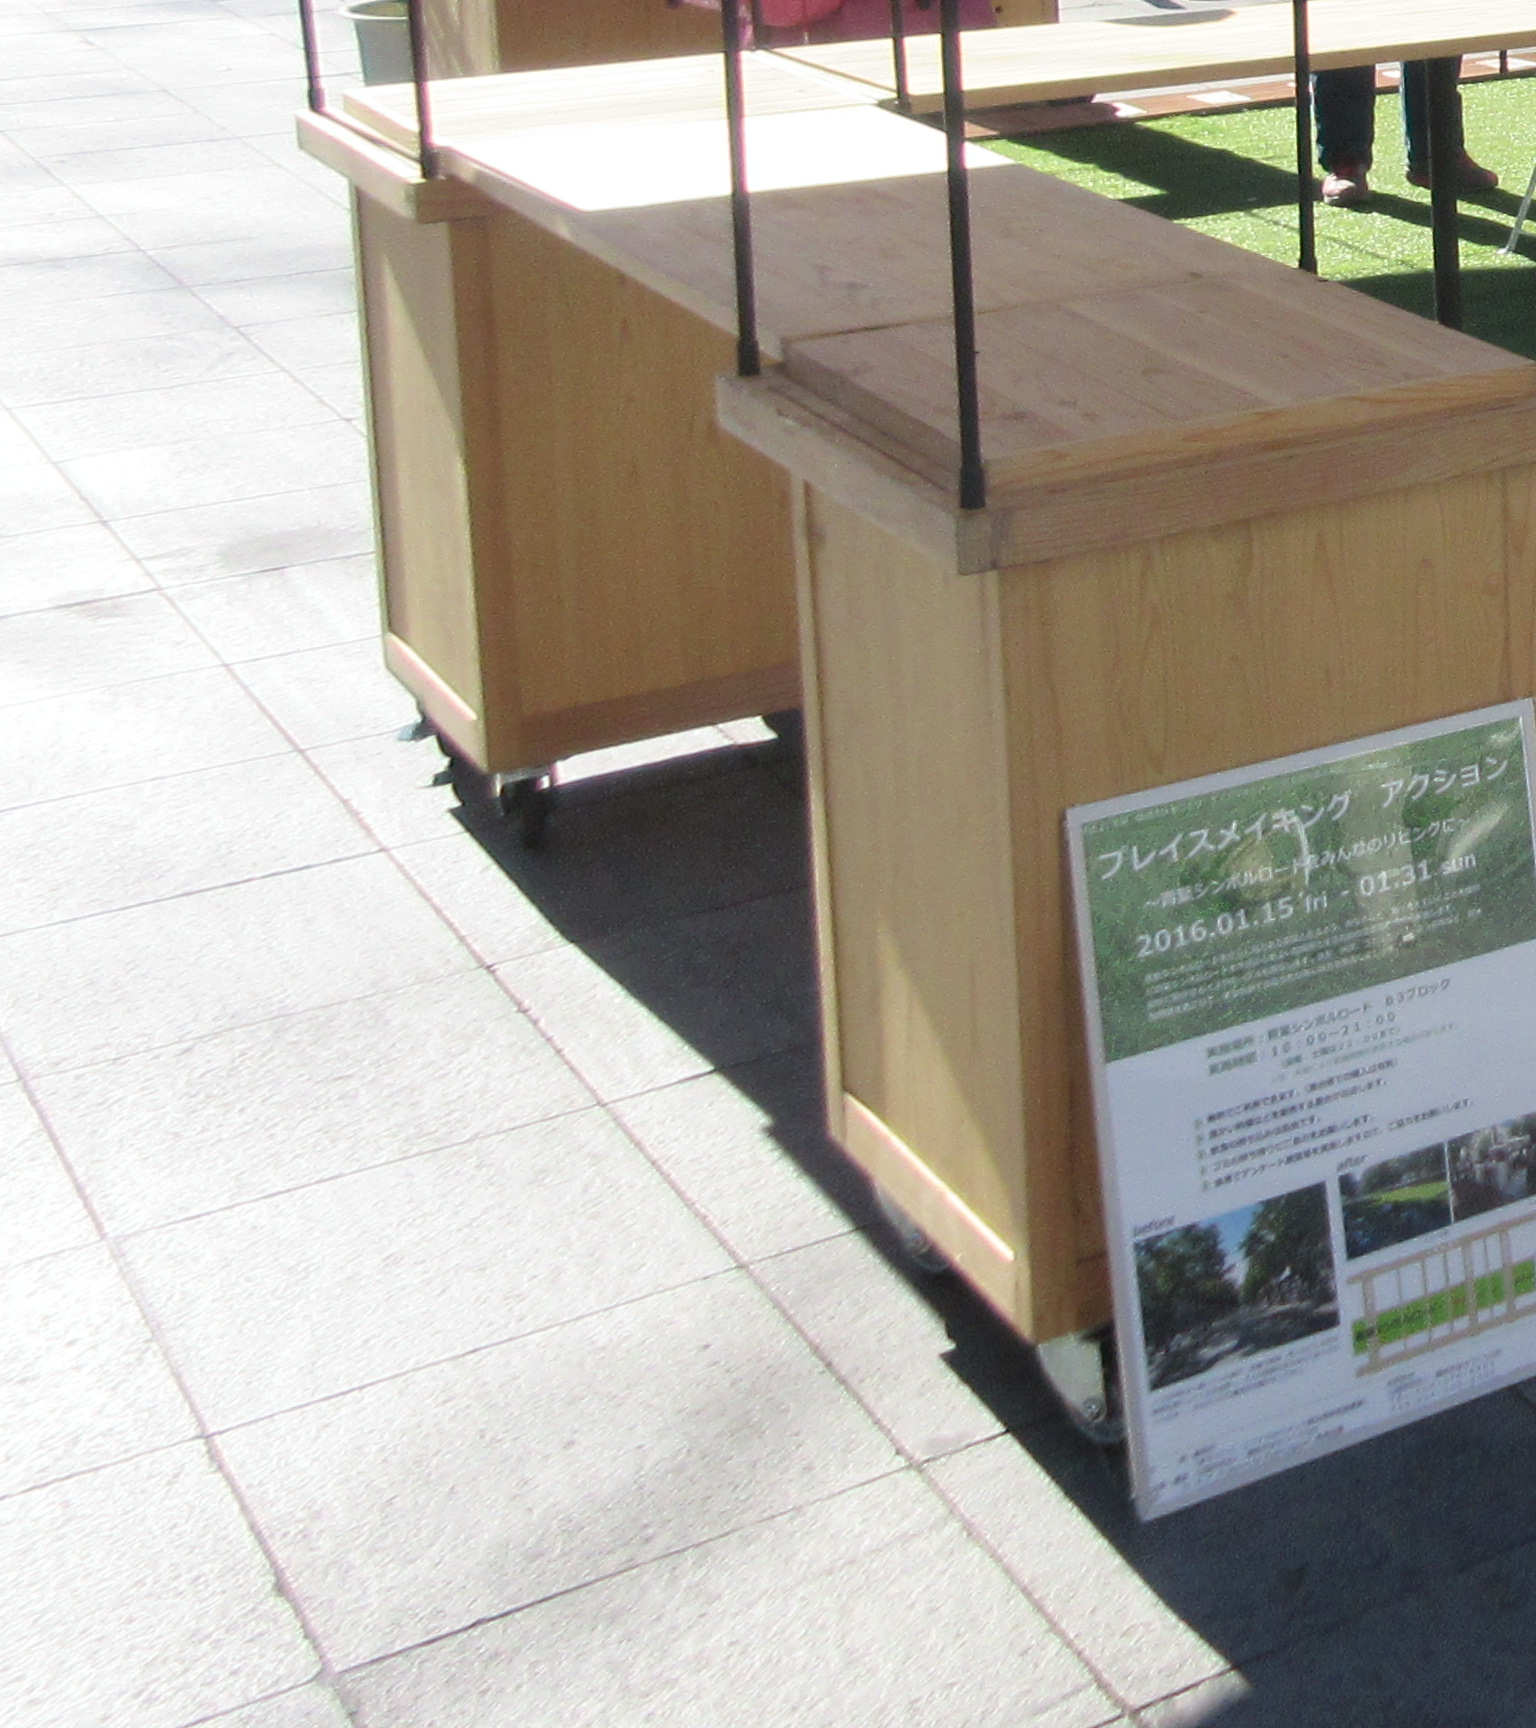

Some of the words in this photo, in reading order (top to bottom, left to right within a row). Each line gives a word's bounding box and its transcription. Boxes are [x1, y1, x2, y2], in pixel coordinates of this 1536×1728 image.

[1098, 791, 1352, 881] プレイスメイキング
[1379, 756, 1512, 816] アクション
[1135, 895, 1295, 959] 2016.01.15
[1360, 857, 1431, 898] 01.31
[1439, 853, 1478, 876] sun
